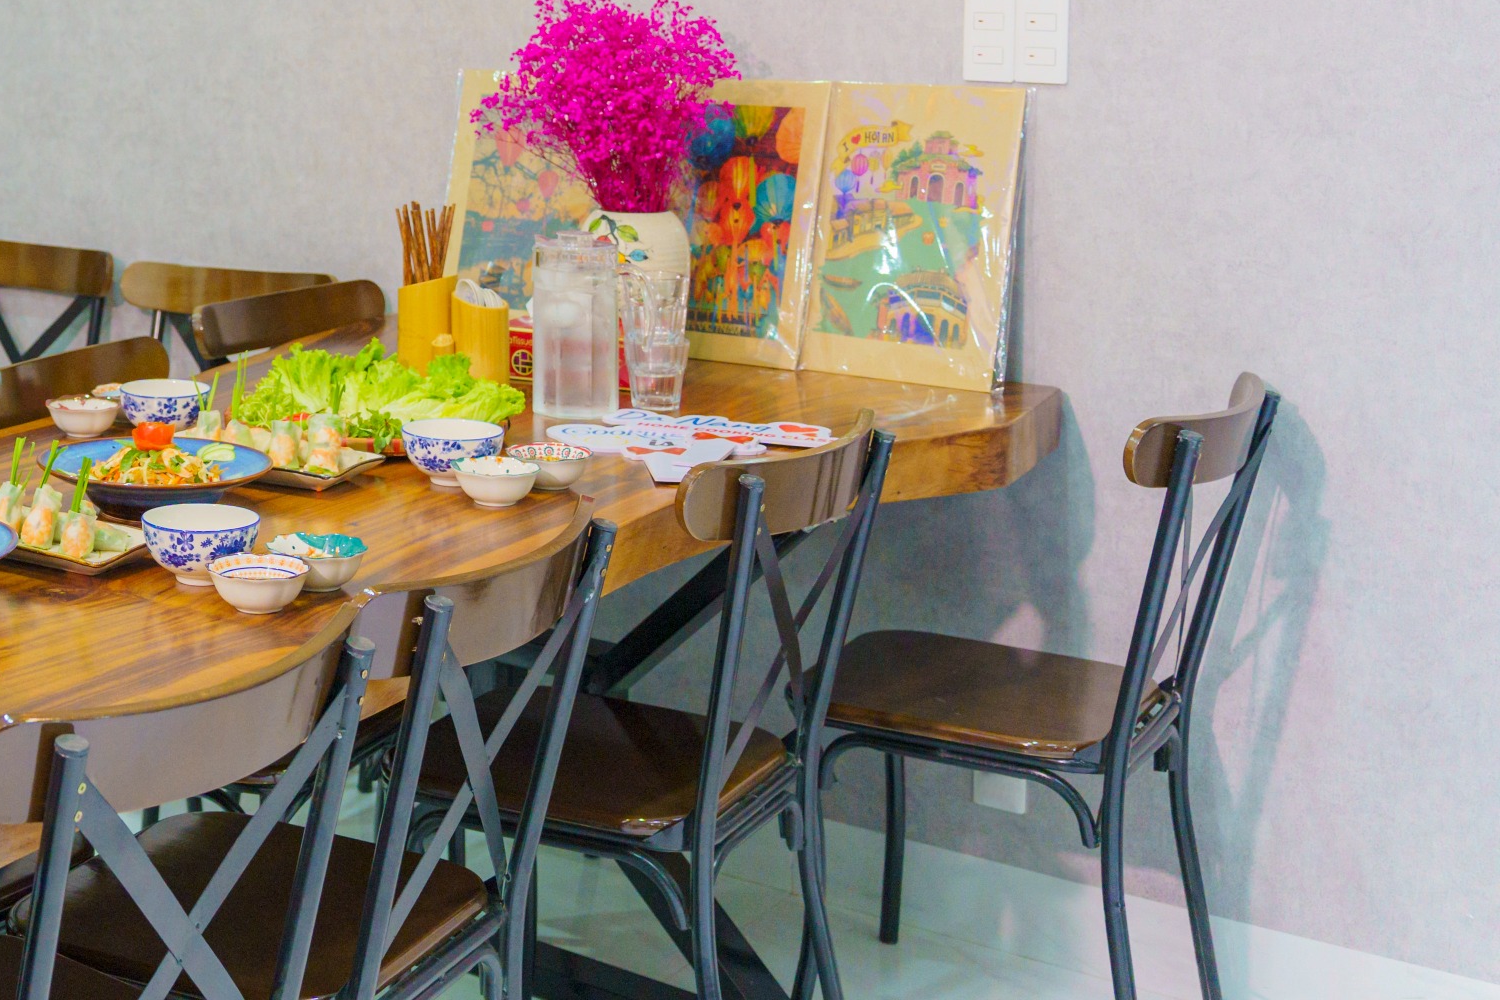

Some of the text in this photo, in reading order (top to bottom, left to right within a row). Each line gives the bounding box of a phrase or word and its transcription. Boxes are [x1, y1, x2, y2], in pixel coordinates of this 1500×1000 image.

[842, 142, 850, 153] I
[614, 410, 771, 433] Da Nang
[636, 422, 688, 431] HOME
[694, 427, 778, 440] COOKING
